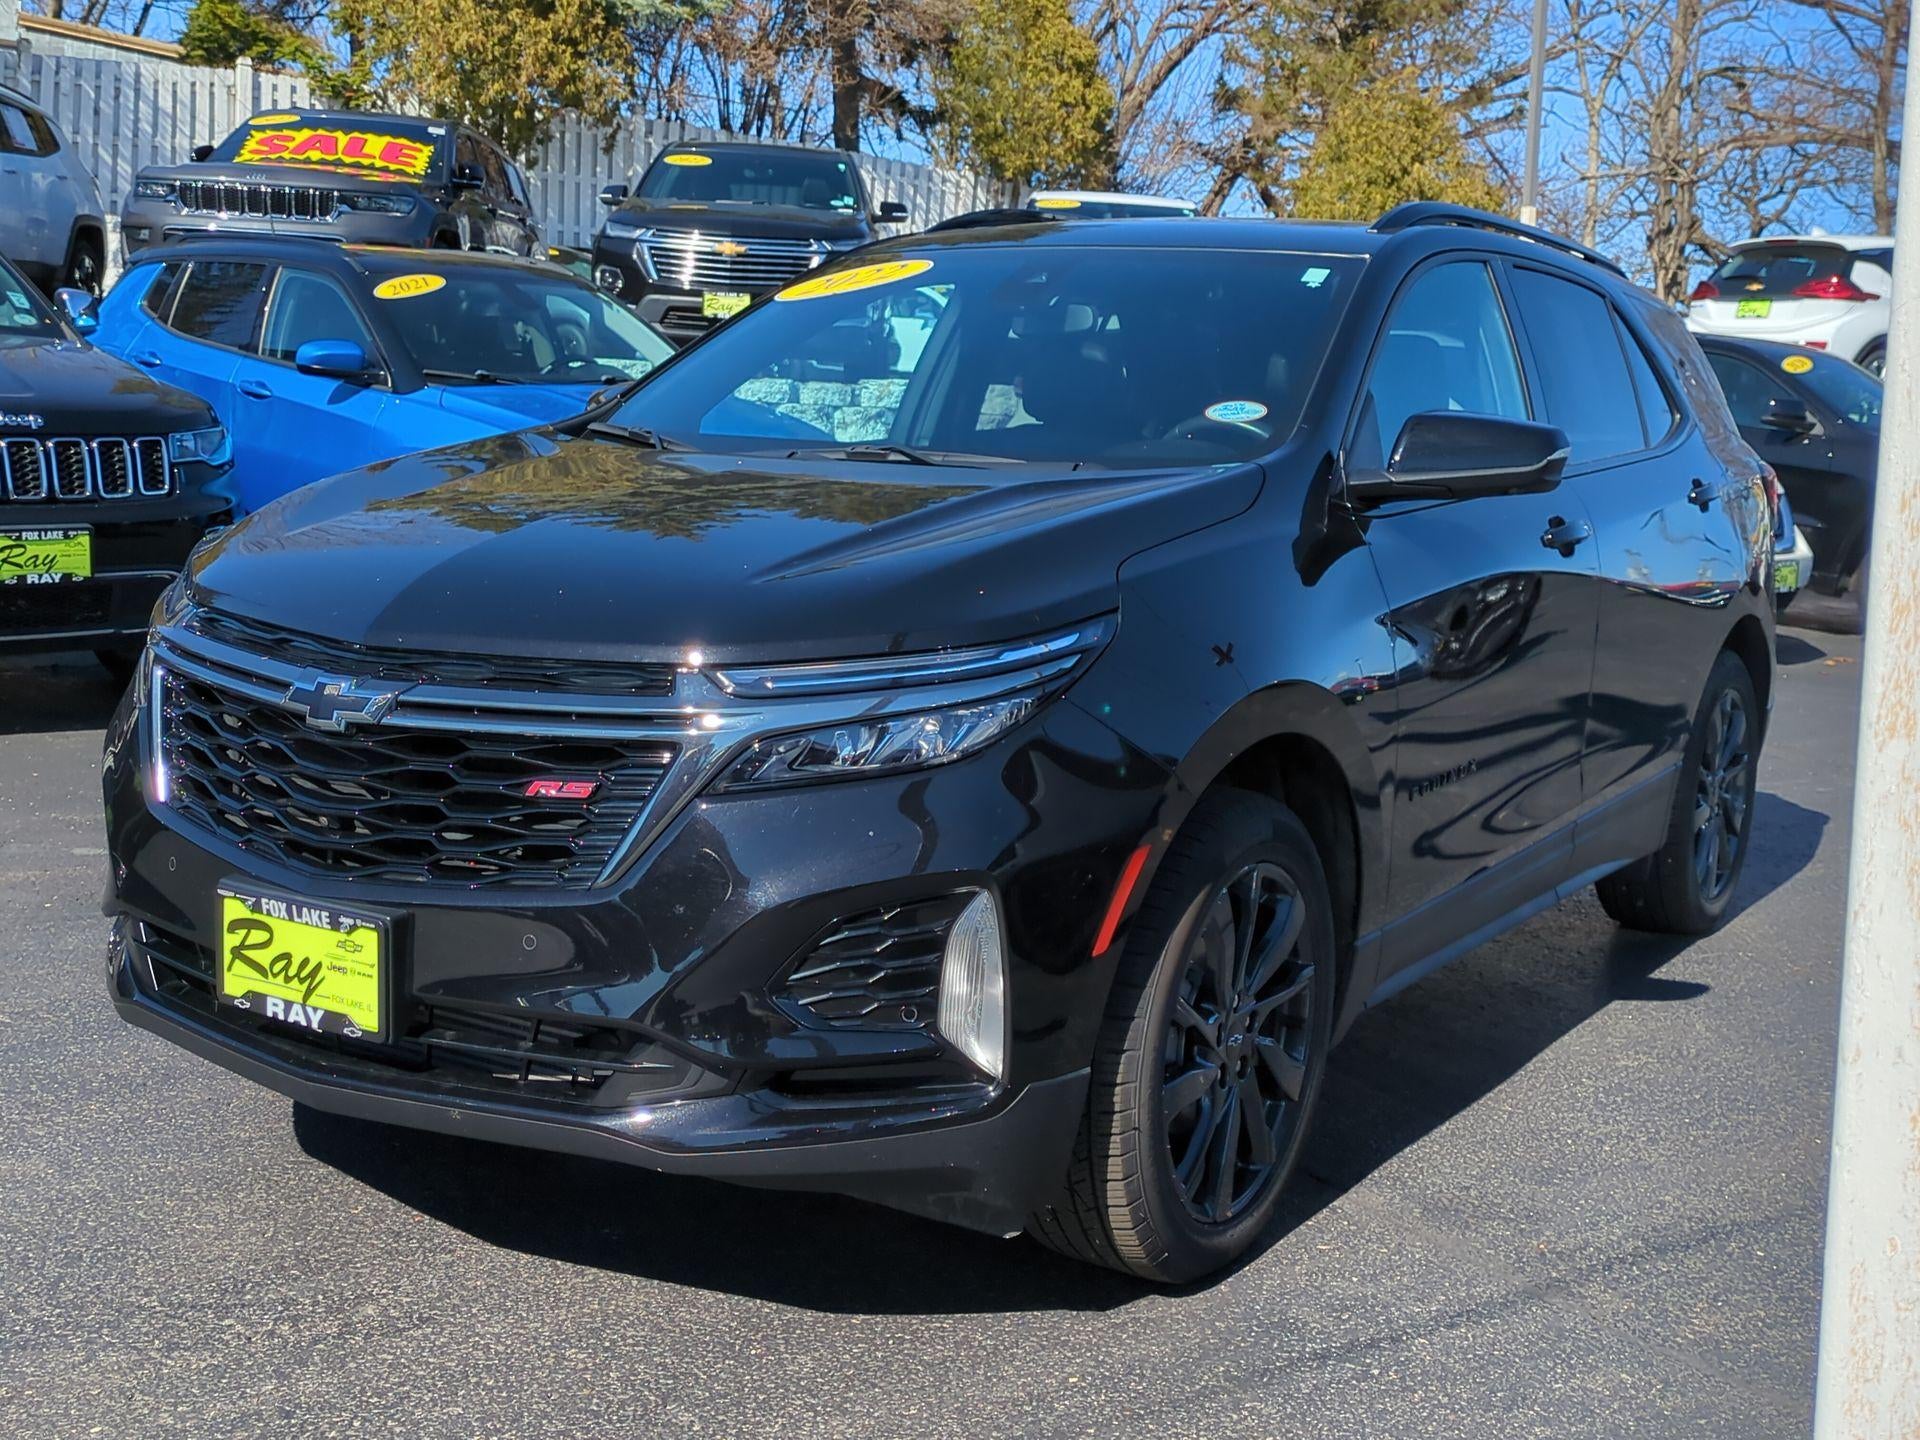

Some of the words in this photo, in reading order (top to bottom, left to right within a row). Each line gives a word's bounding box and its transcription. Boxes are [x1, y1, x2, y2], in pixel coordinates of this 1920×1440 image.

[250, 134, 422, 167] SALE
[386, 277, 429, 296] 2021
[706, 298, 733, 314] Ray
[22, 531, 40, 540] FOX
[41, 530, 65, 540] LAKE
[0, 543, 59, 573] Ray
[26, 573, 63, 584] RAY
[525, 781, 594, 798] RS
[261, 897, 289, 920] FOX
[291, 904, 332, 929] LAKE
[227, 917, 326, 1004] Ray
[326, 961, 348, 976] Jeep
[331, 994, 345, 1004] FOX
[266, 996, 325, 1033] RAY
